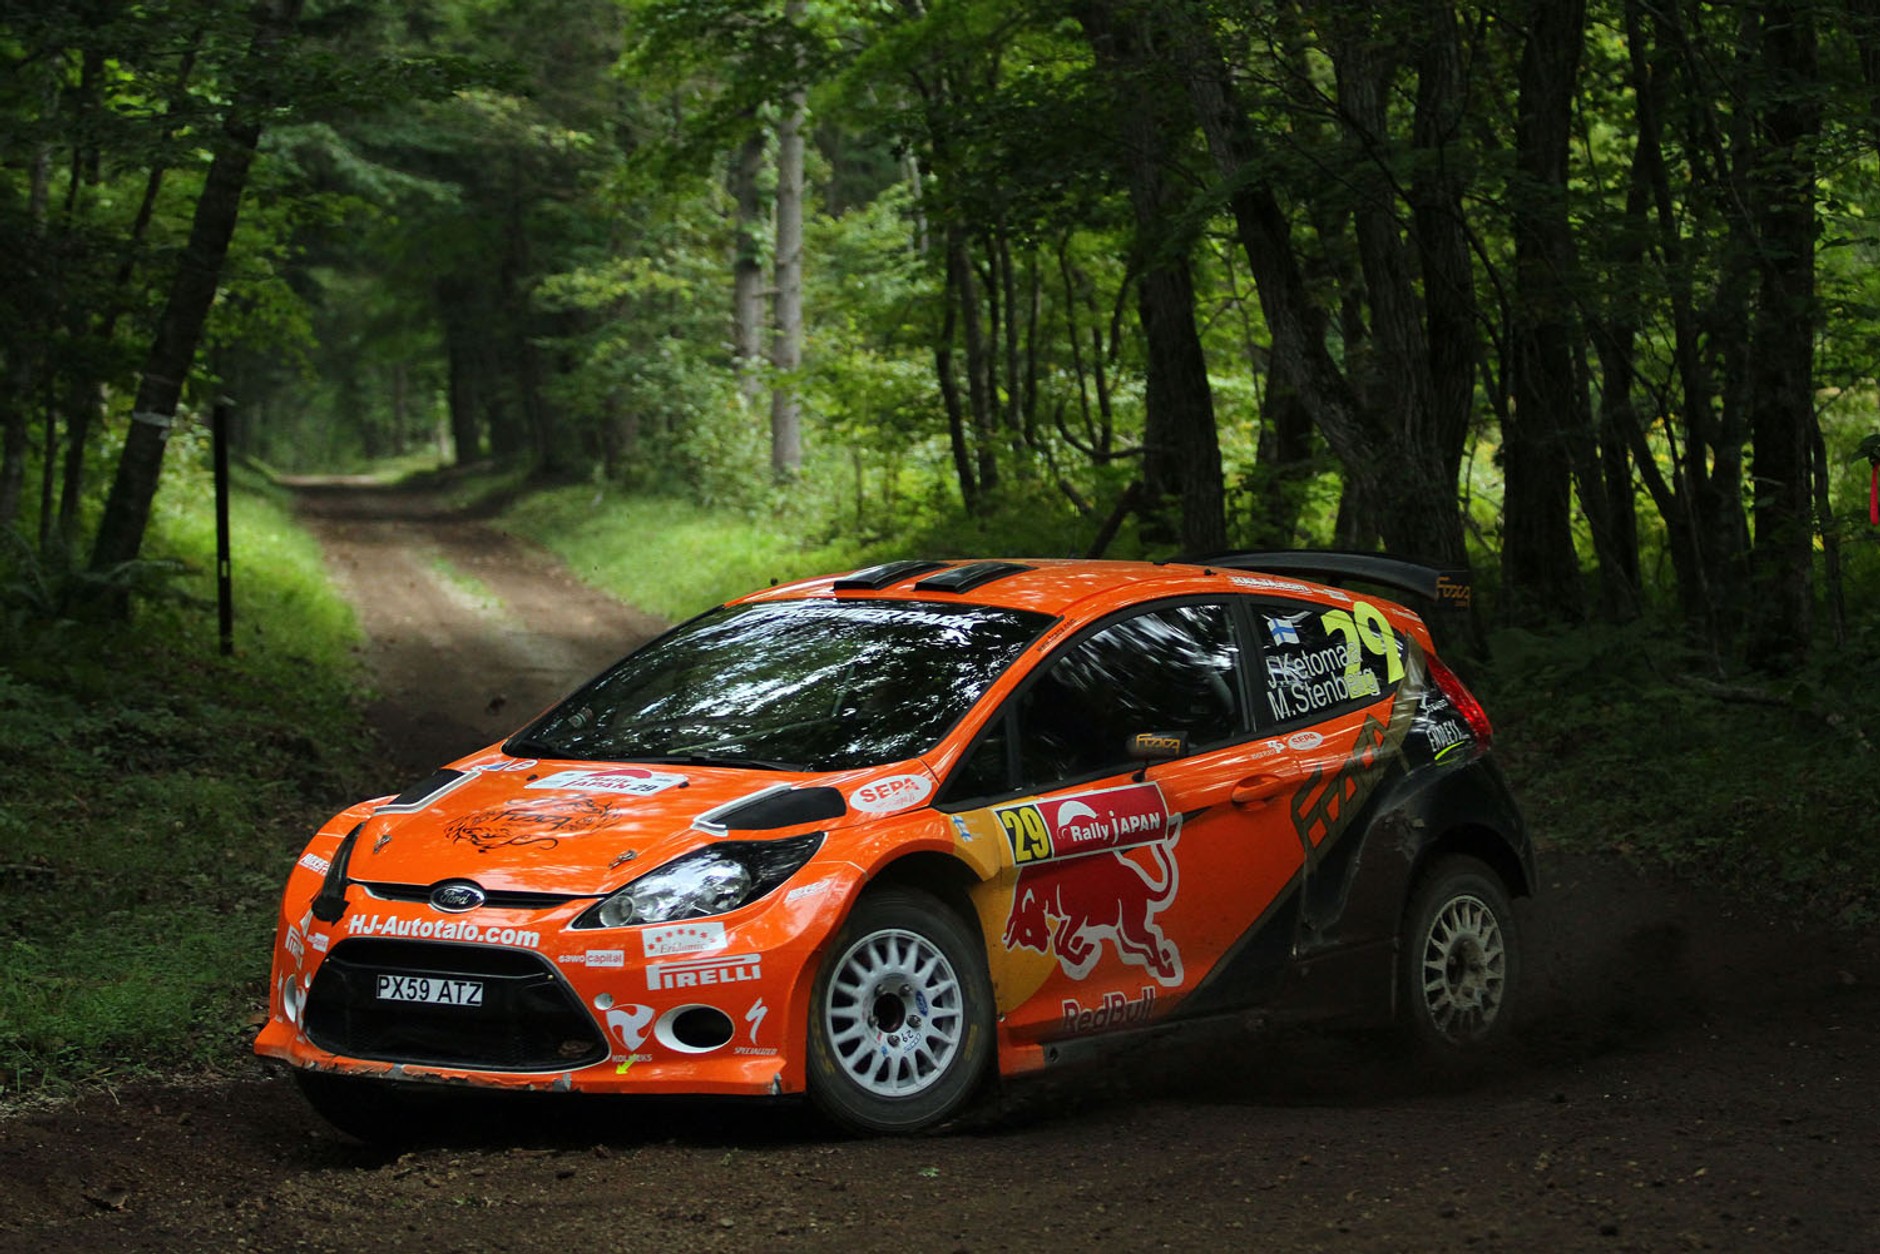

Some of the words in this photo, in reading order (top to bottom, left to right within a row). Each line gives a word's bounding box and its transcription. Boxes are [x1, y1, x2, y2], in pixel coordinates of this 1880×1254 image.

[1321, 601, 1406, 699] 29
[1292, 733, 1317, 745] SEPA
[859, 777, 920, 803] SEPA
[1004, 806, 1051, 862] 29
[1071, 822, 1110, 843] Rally
[348, 914, 540, 948] HJ-Autotalo.com
[587, 953, 622, 964] capital
[646, 953, 762, 991] PIRELLI
[378, 976, 431, 1001] PX59
[437, 980, 483, 1005] ATZ
